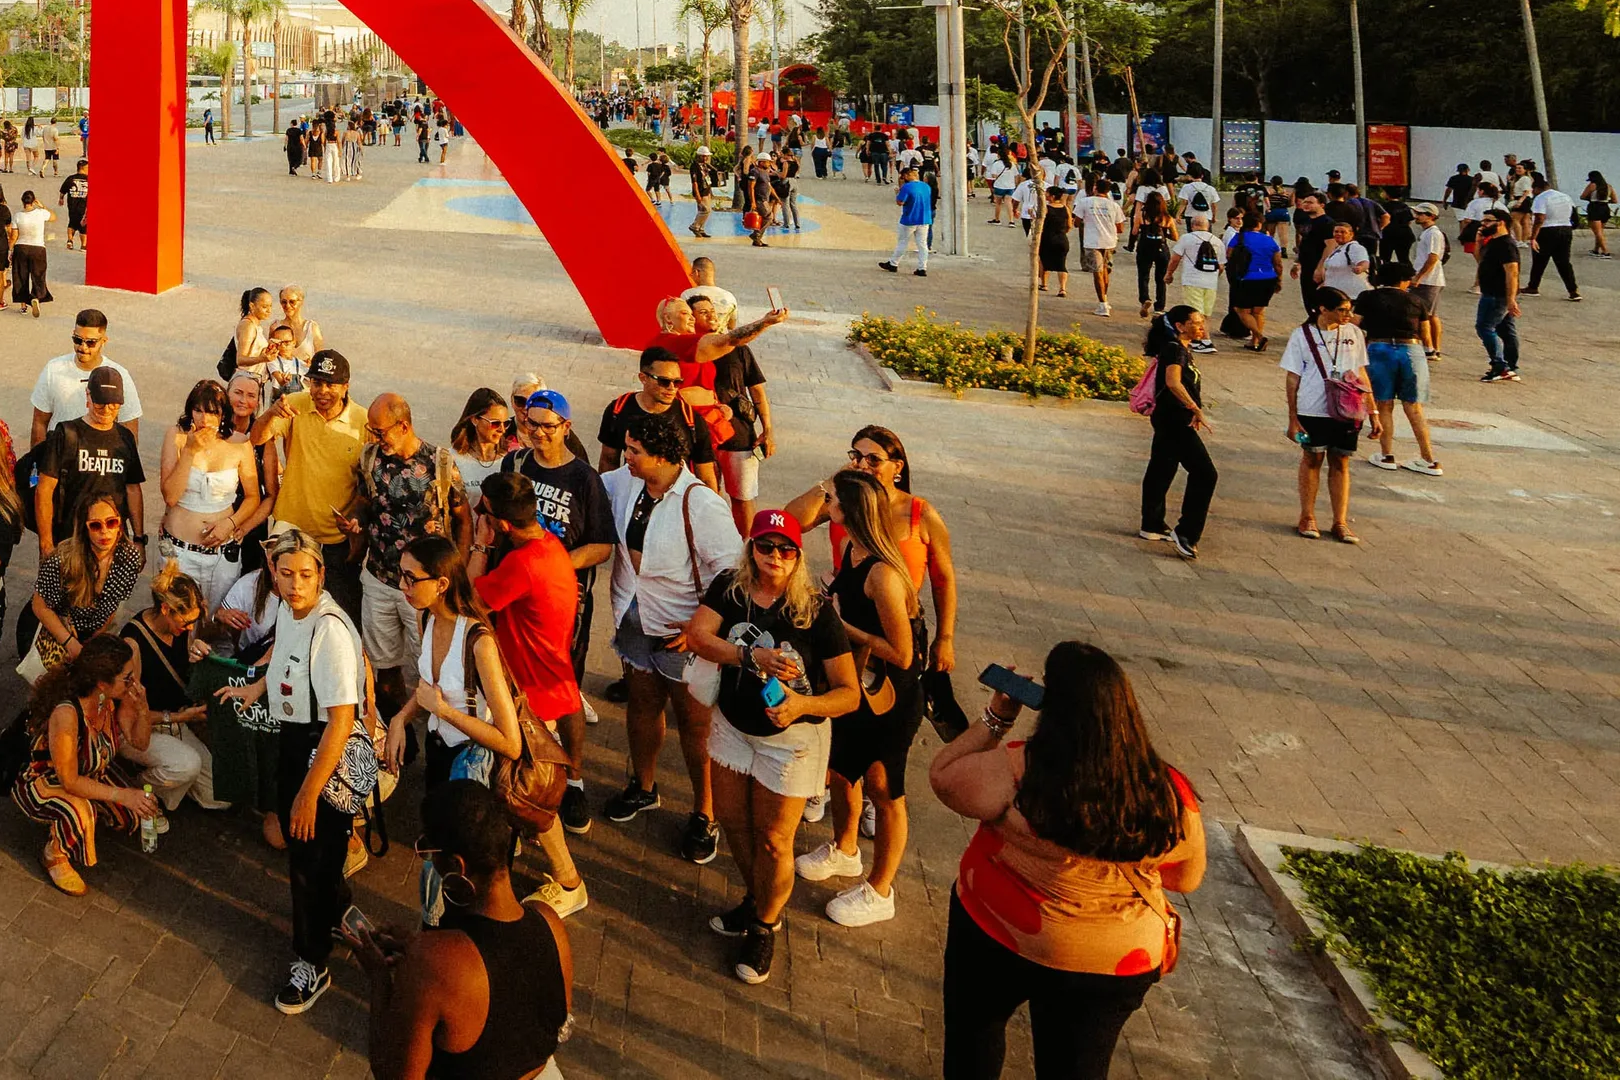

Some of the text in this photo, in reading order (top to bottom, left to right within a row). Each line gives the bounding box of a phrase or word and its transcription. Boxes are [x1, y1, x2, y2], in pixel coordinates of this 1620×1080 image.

[96, 449, 109, 457] THE
[78, 449, 125, 476] BEATLES
[769, 513, 785, 528] NY
